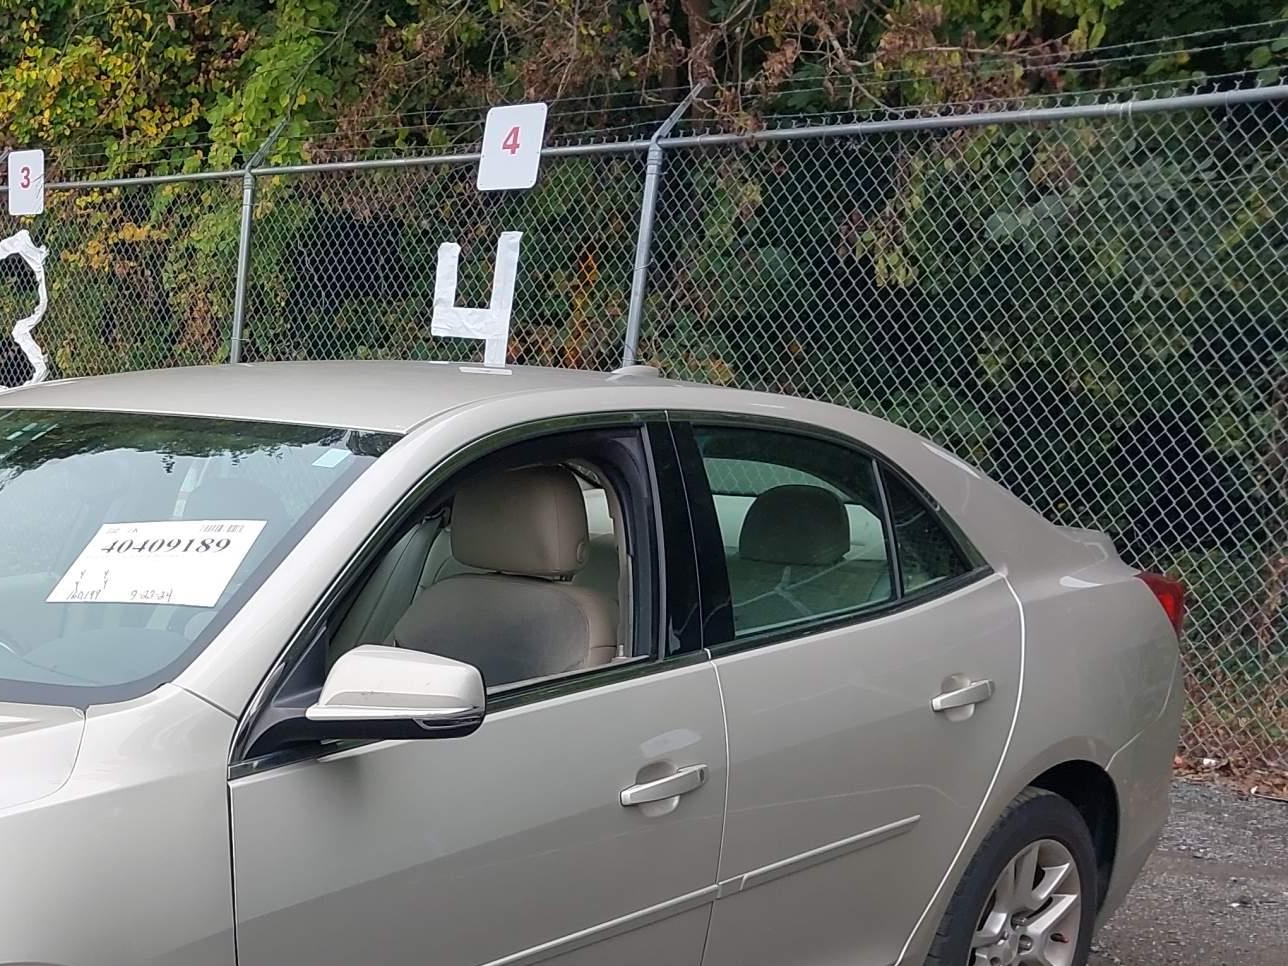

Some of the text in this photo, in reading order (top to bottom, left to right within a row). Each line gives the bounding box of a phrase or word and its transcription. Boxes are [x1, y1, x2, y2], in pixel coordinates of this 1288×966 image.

[502, 126, 520, 155] 4
[20, 166, 31, 189] 3
[431, 231, 523, 367] 4
[101, 538, 231, 554] 40409189
